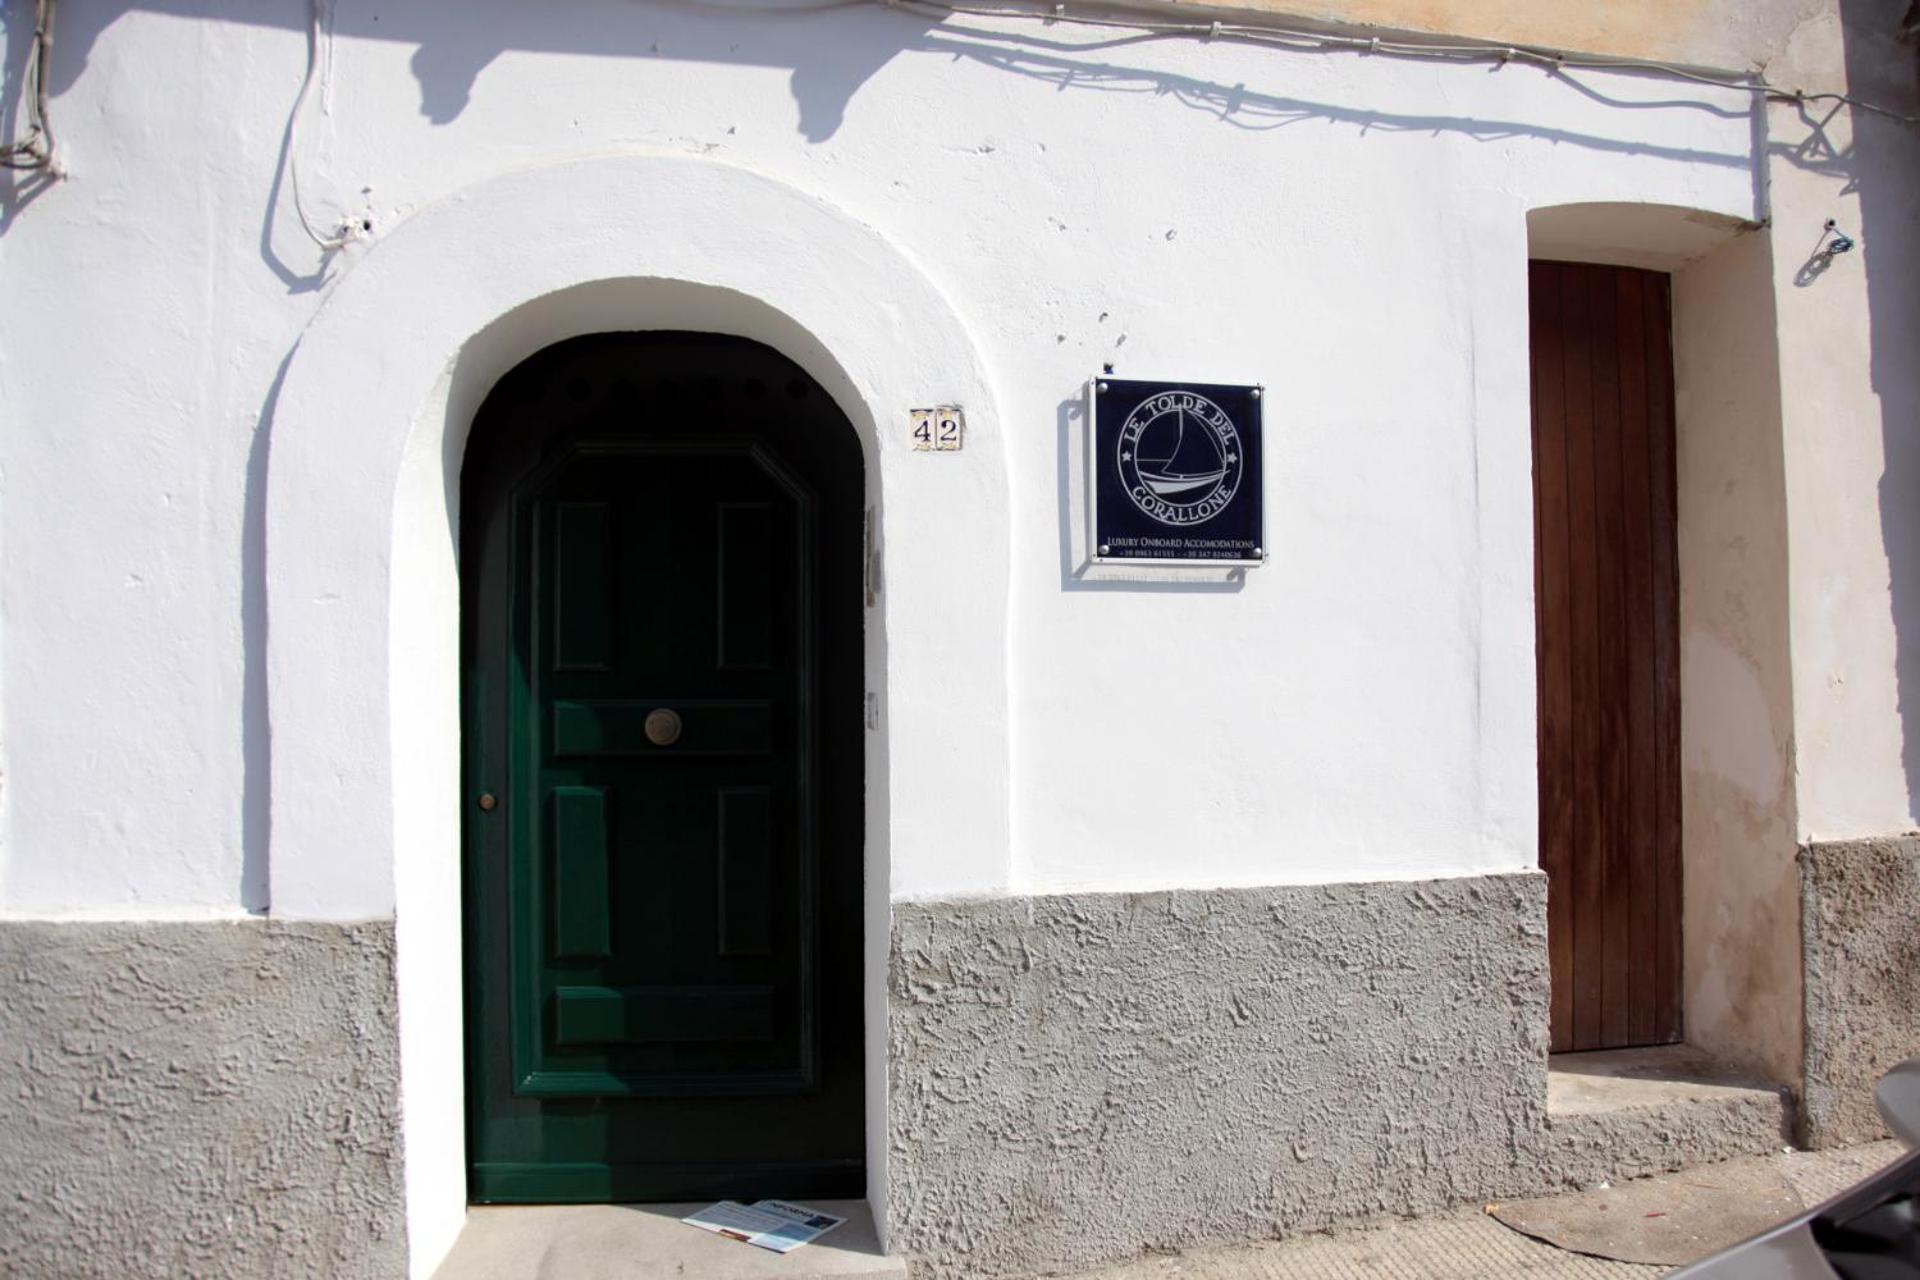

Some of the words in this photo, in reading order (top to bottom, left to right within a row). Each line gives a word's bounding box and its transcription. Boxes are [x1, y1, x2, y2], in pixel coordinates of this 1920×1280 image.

[914, 419, 957, 442] 42
[1124, 418, 1145, 443] LE
[1145, 395, 1207, 416] TOLDE
[1209, 412, 1236, 445] DEL
[1131, 485, 1232, 522] CORALLONE
